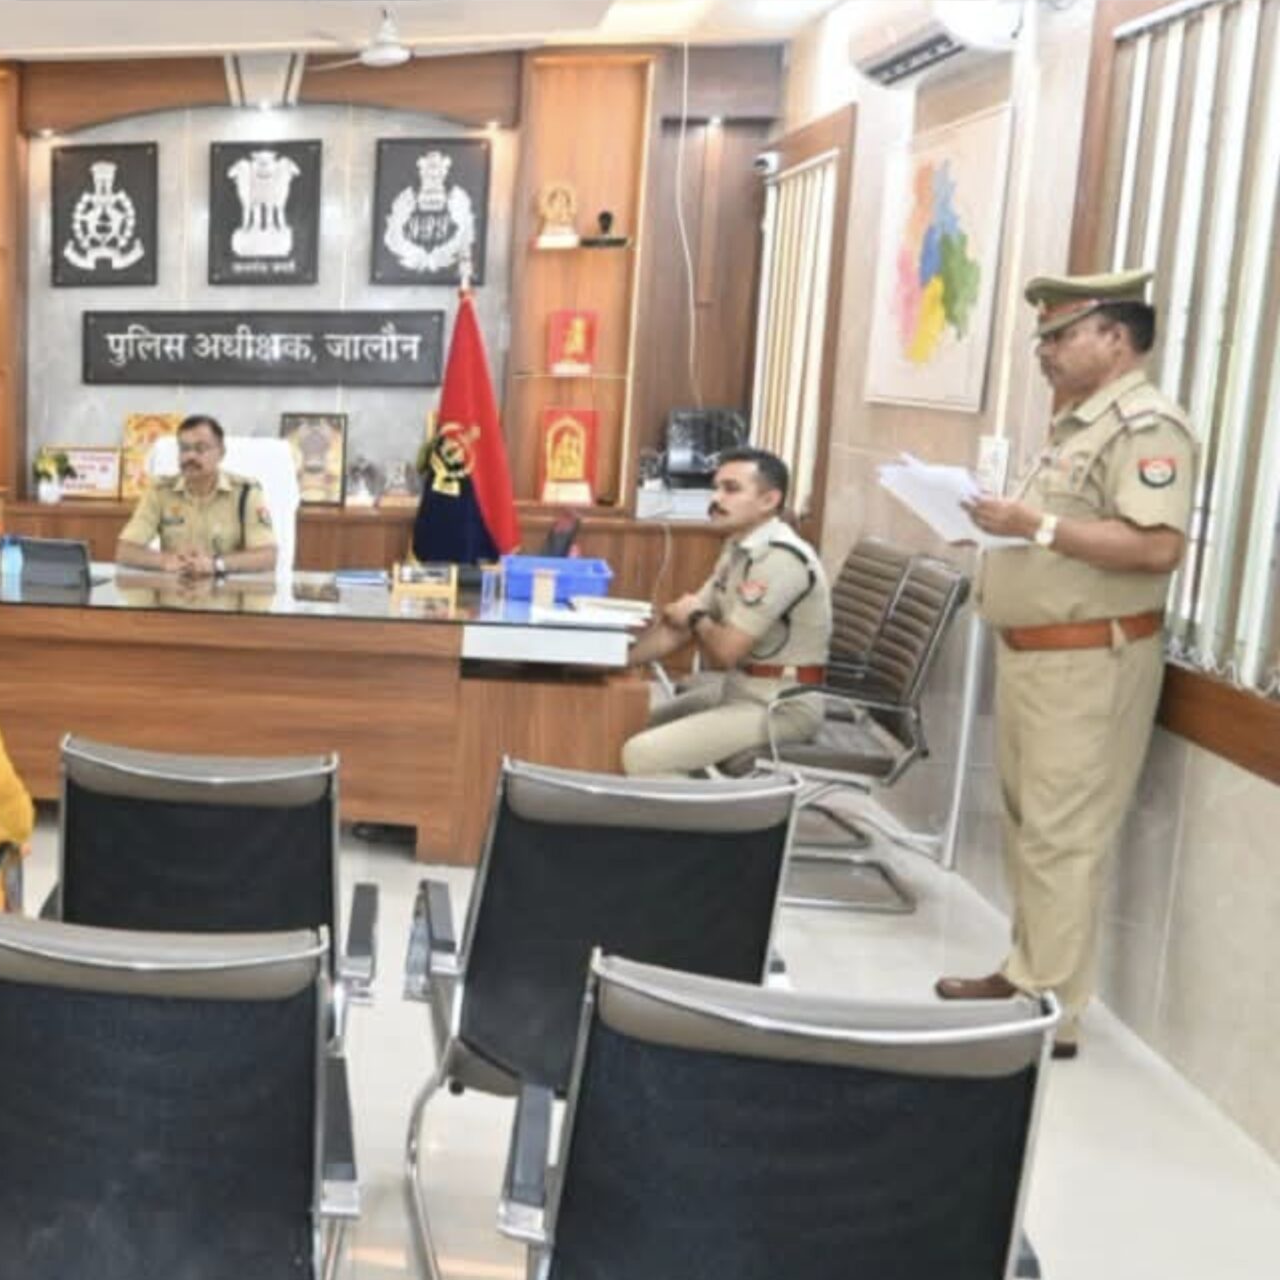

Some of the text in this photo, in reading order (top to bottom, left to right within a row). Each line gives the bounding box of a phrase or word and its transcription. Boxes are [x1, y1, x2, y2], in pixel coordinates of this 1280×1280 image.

[105, 323, 422, 367] पुलिस अधीक्षक, जालौन
